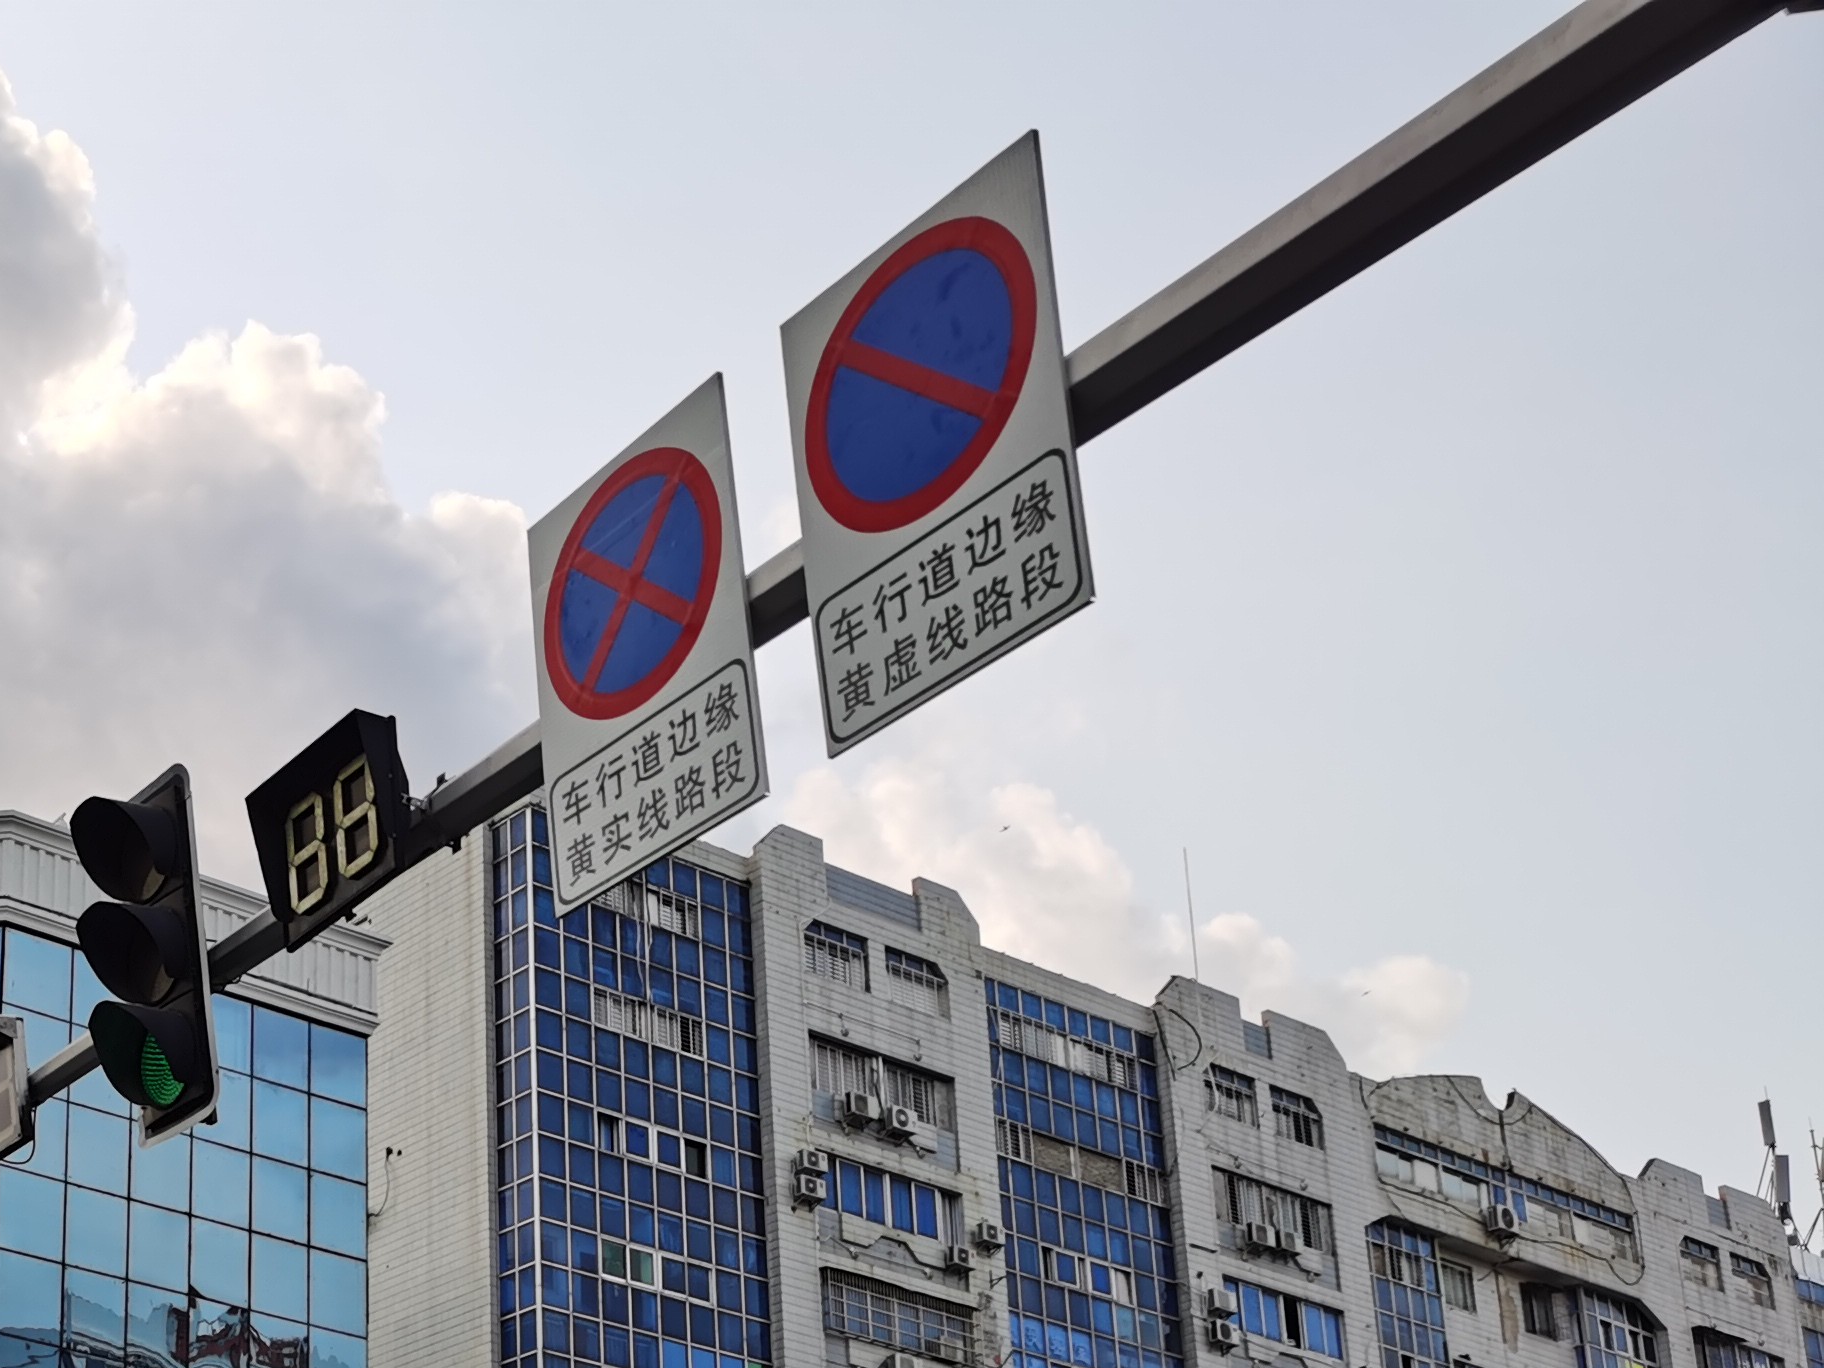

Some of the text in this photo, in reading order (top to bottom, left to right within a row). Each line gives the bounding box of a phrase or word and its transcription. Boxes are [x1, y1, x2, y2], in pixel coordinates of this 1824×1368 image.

[830, 478, 1057, 657] 车行道边缘
[836, 542, 1065, 724] 黄虚线路段
[561, 682, 741, 827] 车行道边缘
[565, 740, 747, 888] 黄实线路段
